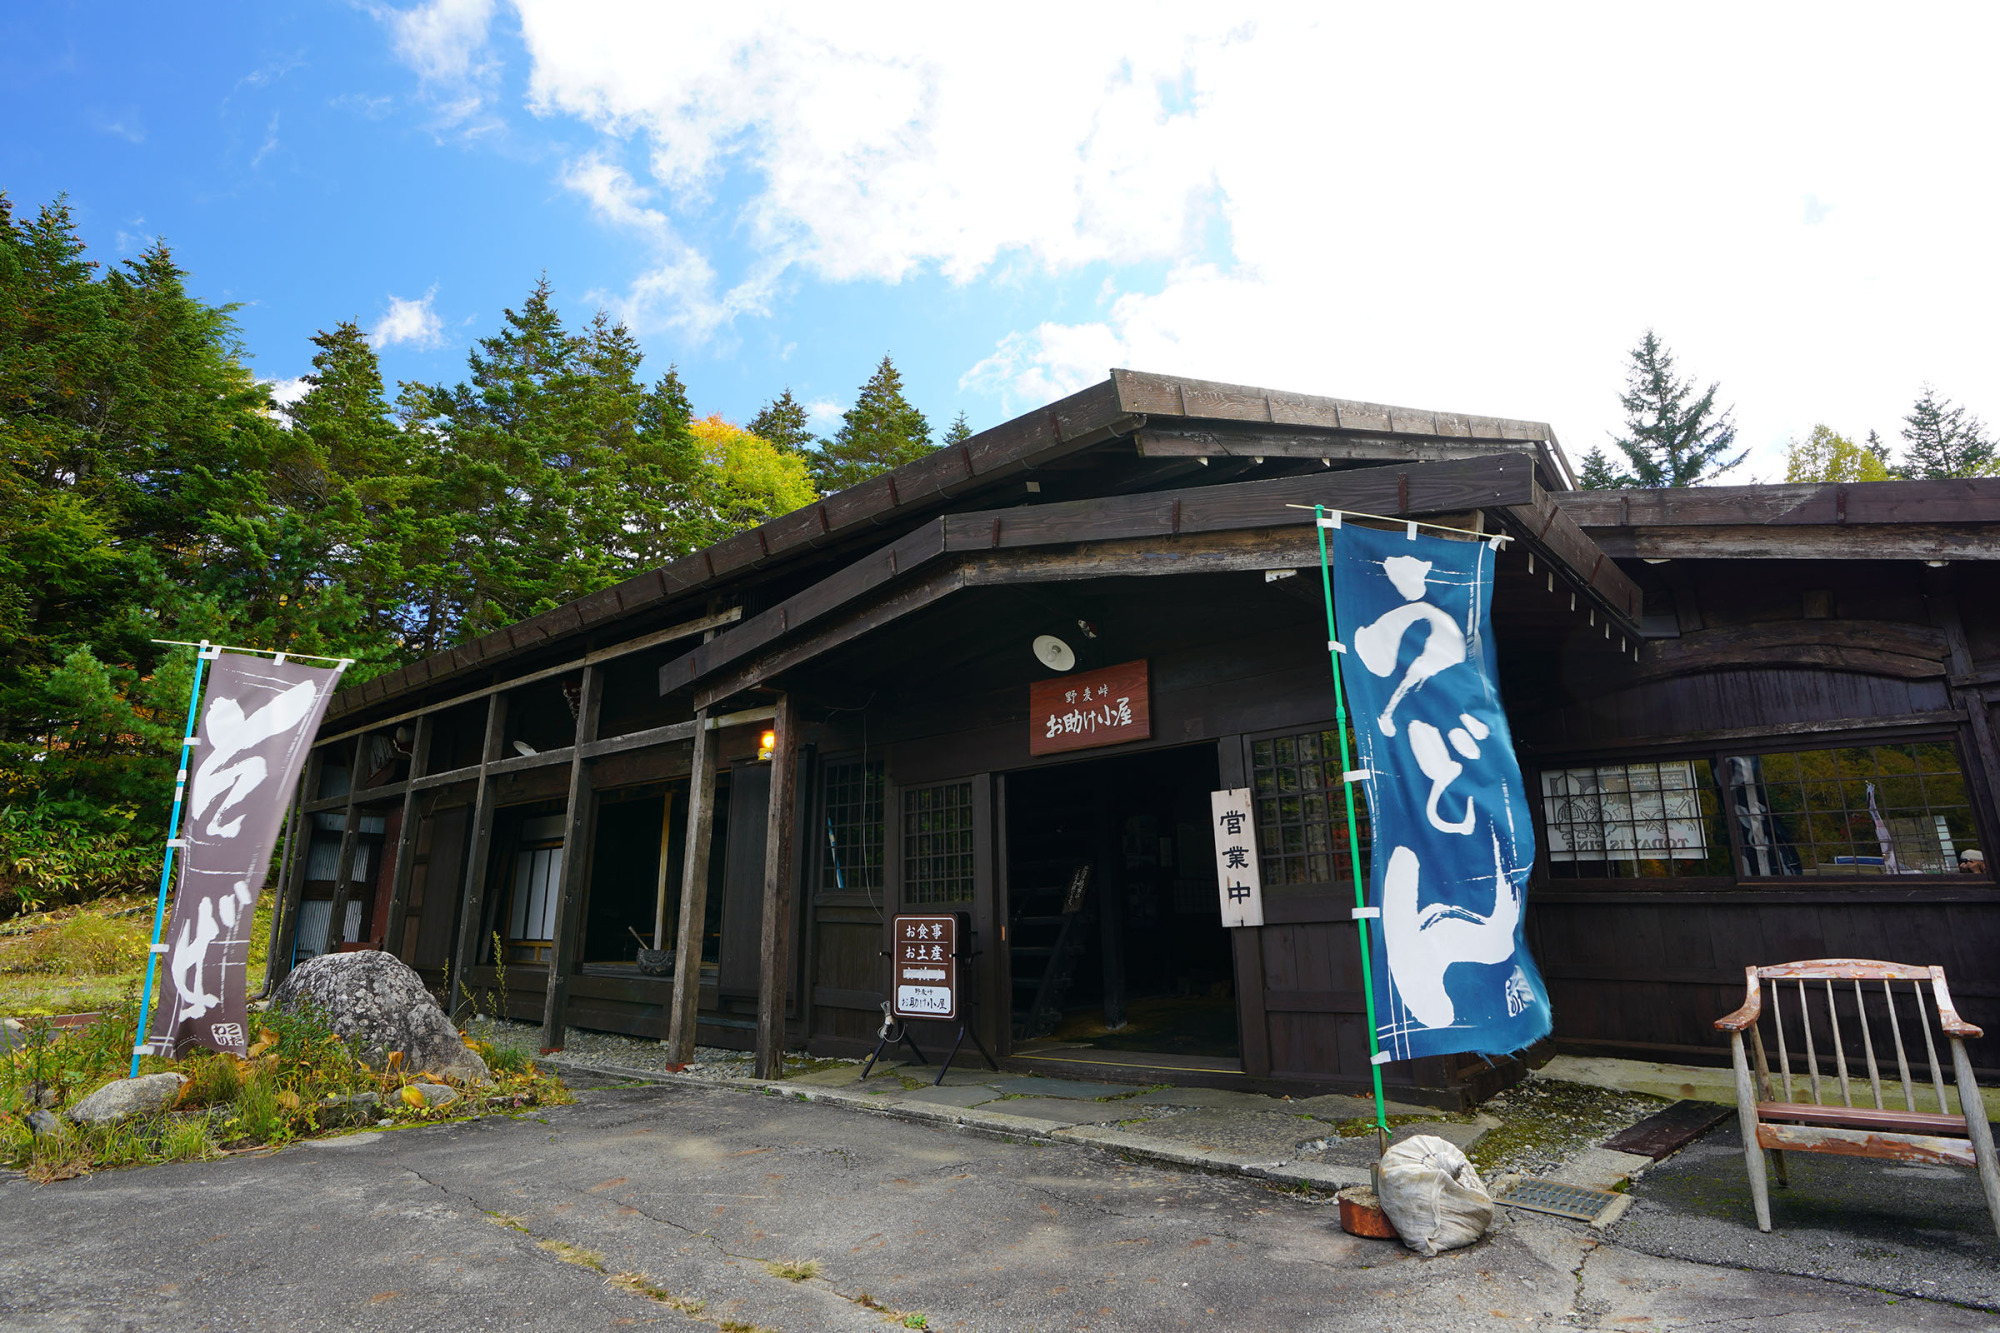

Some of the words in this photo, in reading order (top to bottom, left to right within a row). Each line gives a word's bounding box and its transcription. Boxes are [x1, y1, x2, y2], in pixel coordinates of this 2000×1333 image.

[1064, 683, 1109, 705] 野麦峠
[1045, 696, 1133, 739] お助け小屋
[1354, 555, 1521, 1028] うどん
[171, 679, 317, 1023] そば
[1219, 810, 1251, 905] 営業中
[905, 923, 943, 940] お食事
[905, 944, 944, 961] お土産
[901, 996, 947, 1010] お助け小屋
